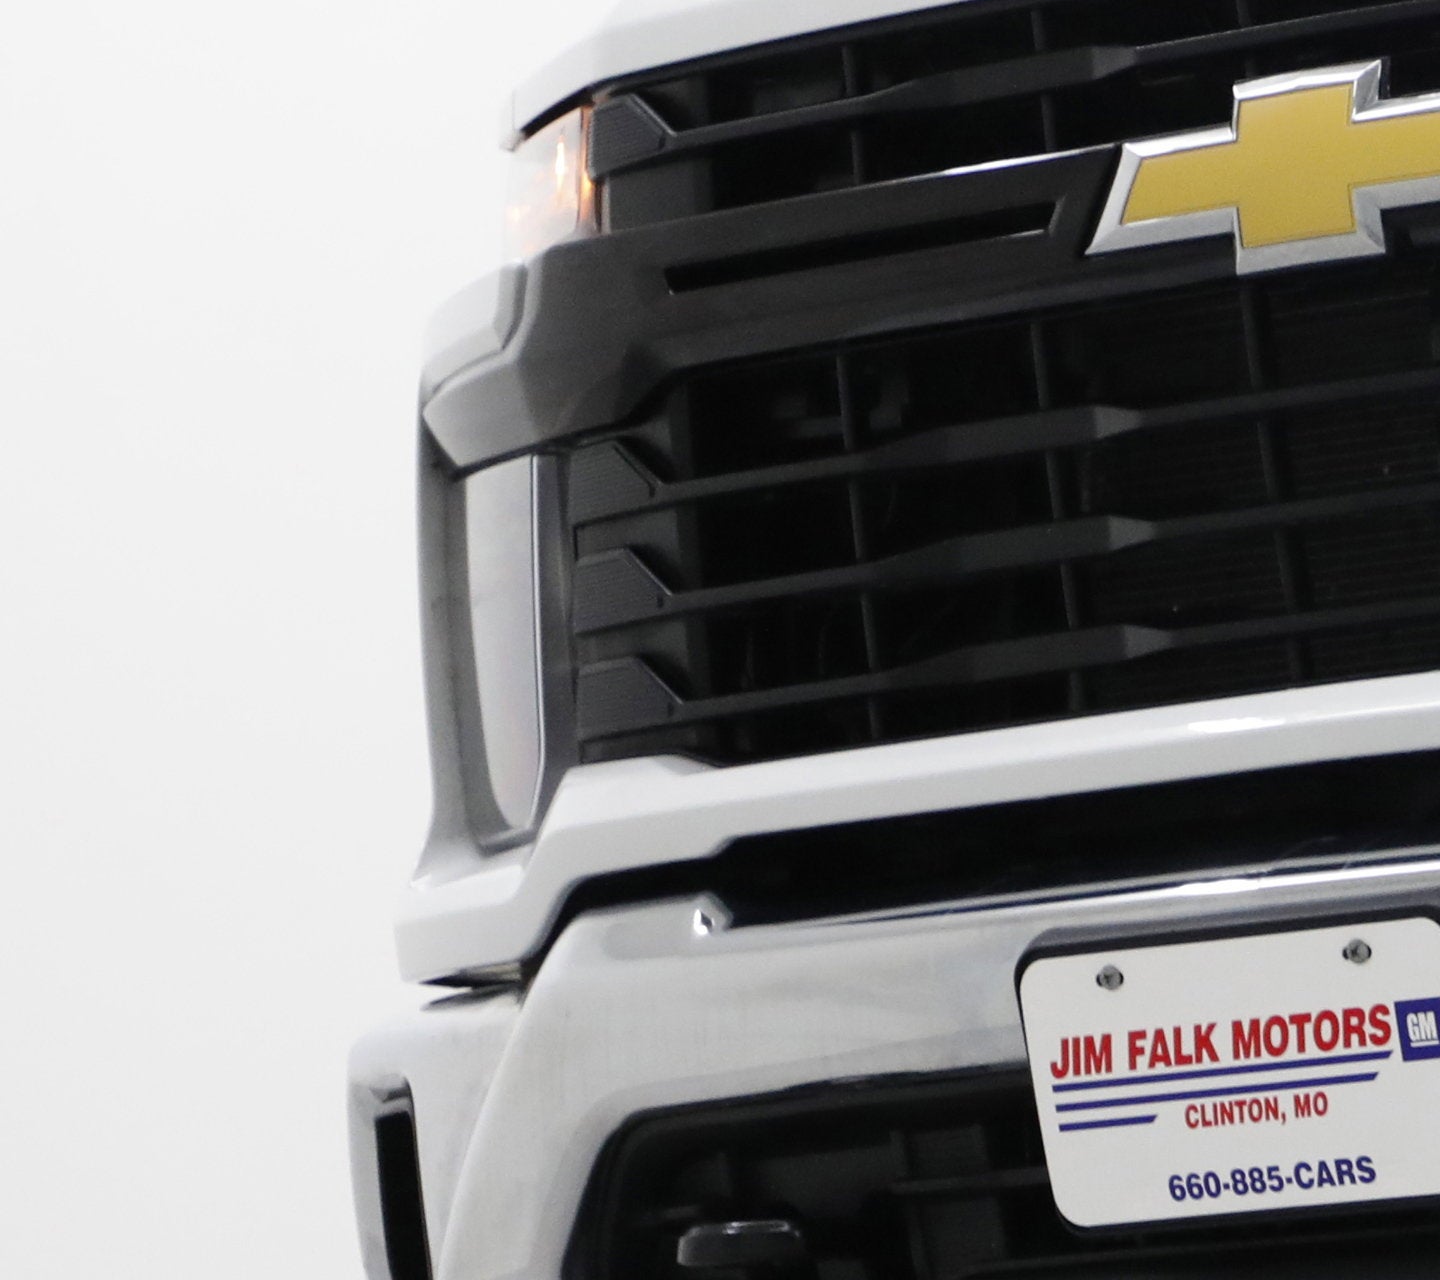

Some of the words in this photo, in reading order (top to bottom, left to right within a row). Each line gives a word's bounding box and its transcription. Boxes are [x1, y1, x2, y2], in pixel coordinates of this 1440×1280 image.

[1050, 1033, 1114, 1081] JIM
[1127, 1022, 1221, 1072] FALK
[1231, 1003, 1394, 1061] MOTORS
[1406, 1009, 1440, 1048] GM
[1185, 1097, 1286, 1130] CLINTON,
[1293, 1091, 1330, 1119] MO
[1167, 1155, 1378, 1203] 660-885-CARS
